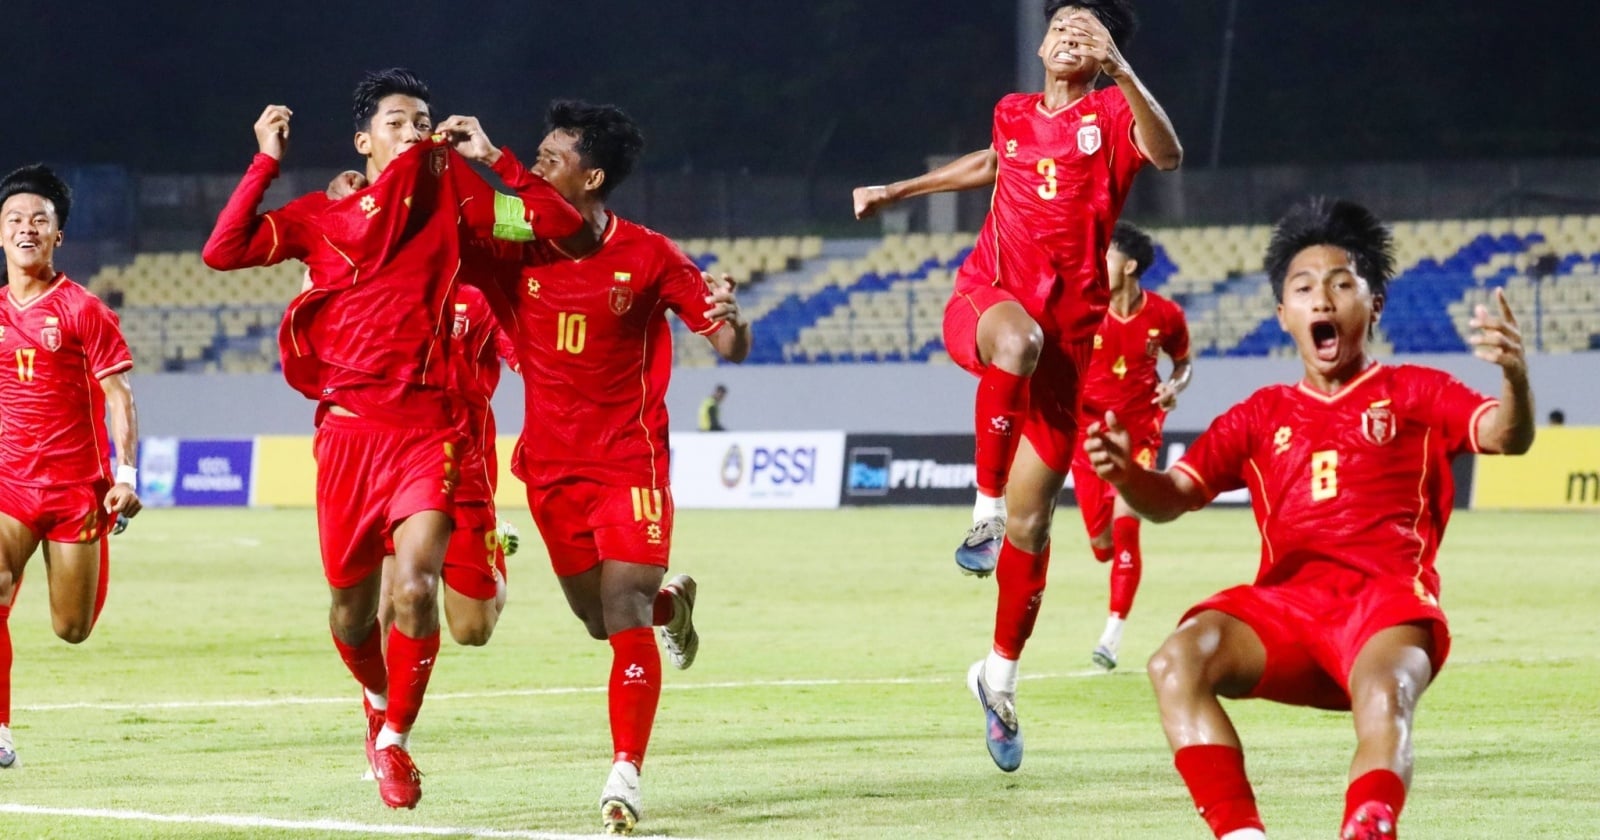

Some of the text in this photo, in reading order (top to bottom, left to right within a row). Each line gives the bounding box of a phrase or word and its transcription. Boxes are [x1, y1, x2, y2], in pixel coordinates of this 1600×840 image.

[1036, 158, 1058, 200] 3
[557, 312, 587, 354] 10
[15, 348, 37, 382] 17
[1111, 355, 1128, 379] 4
[750, 447, 817, 485] PSSI
[889, 460, 921, 489] PT
[1135, 447, 1152, 470] 4
[1311, 449, 1339, 502] 8
[630, 487, 662, 522] 10
